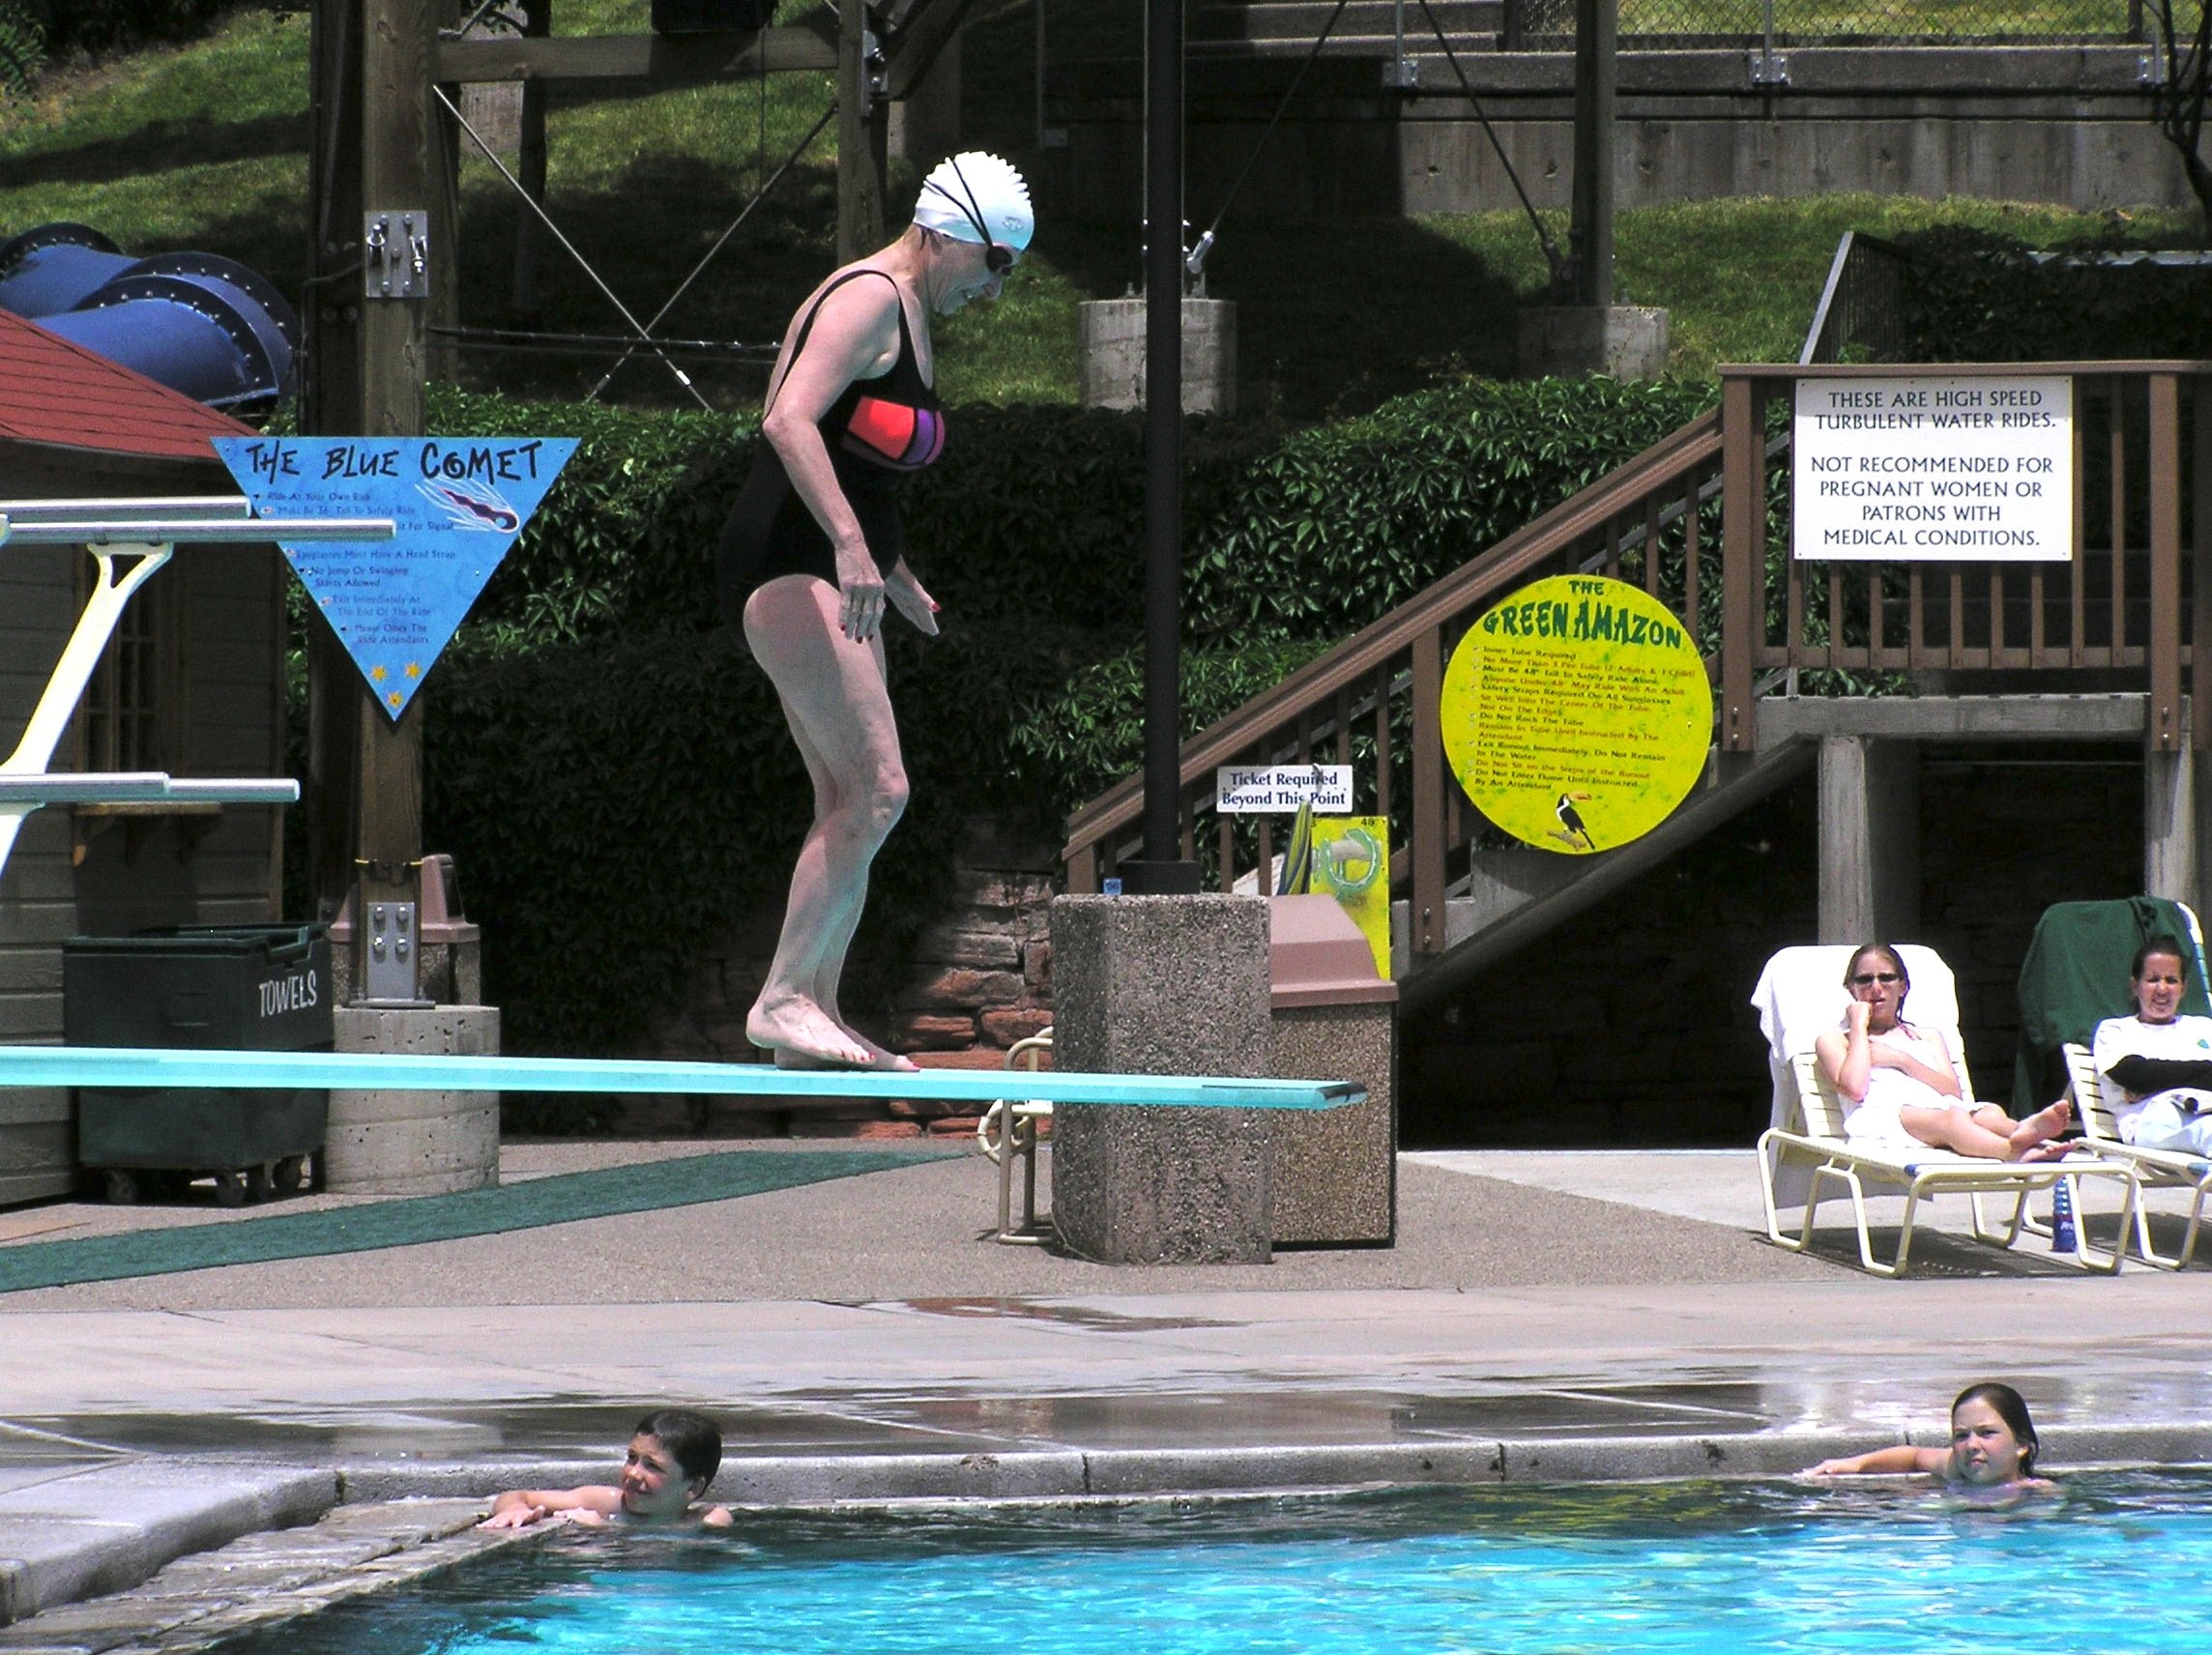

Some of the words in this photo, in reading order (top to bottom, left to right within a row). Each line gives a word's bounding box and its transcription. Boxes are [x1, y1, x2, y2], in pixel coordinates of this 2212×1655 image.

[1827, 391, 1883, 408] THESE
[1891, 391, 1928, 407] ARE
[1936, 390, 1983, 407] HIGH
[1990, 390, 2043, 407] SPEED
[1816, 413, 1925, 430] TURBULENT
[1932, 413, 1994, 429] WATER
[2001, 412, 2056, 428] RIDES.
[246, 440, 300, 484] THE
[322, 445, 399, 479] BLUE
[420, 441, 542, 485] COMET
[1811, 456, 1852, 473] NOT
[1859, 456, 2010, 474] RECOMMENDED
[2017, 456, 2053, 474] FOR
[1819, 480, 1925, 497] PREGNANT
[1932, 481, 2009, 497] WOMEN
[2016, 481, 2043, 497] OR
[1862, 505, 1946, 521] PATRONS
[1953, 505, 2001, 521] WITH
[1823, 529, 1908, 545] MEDICAL
[1915, 529, 2040, 546] CONDITIONS.
[1568, 579, 1606, 595] THE
[1482, 600, 1570, 638] GREEN
[1574, 598, 1681, 650] AMAZON
[1230, 772, 1271, 787] Ticket
[1276, 771, 1338, 788] Required
[1222, 791, 1272, 810] Beyond
[1275, 791, 1305, 805] This
[1310, 791, 1346, 805] Point
[258, 970, 317, 1018] TOWELS
